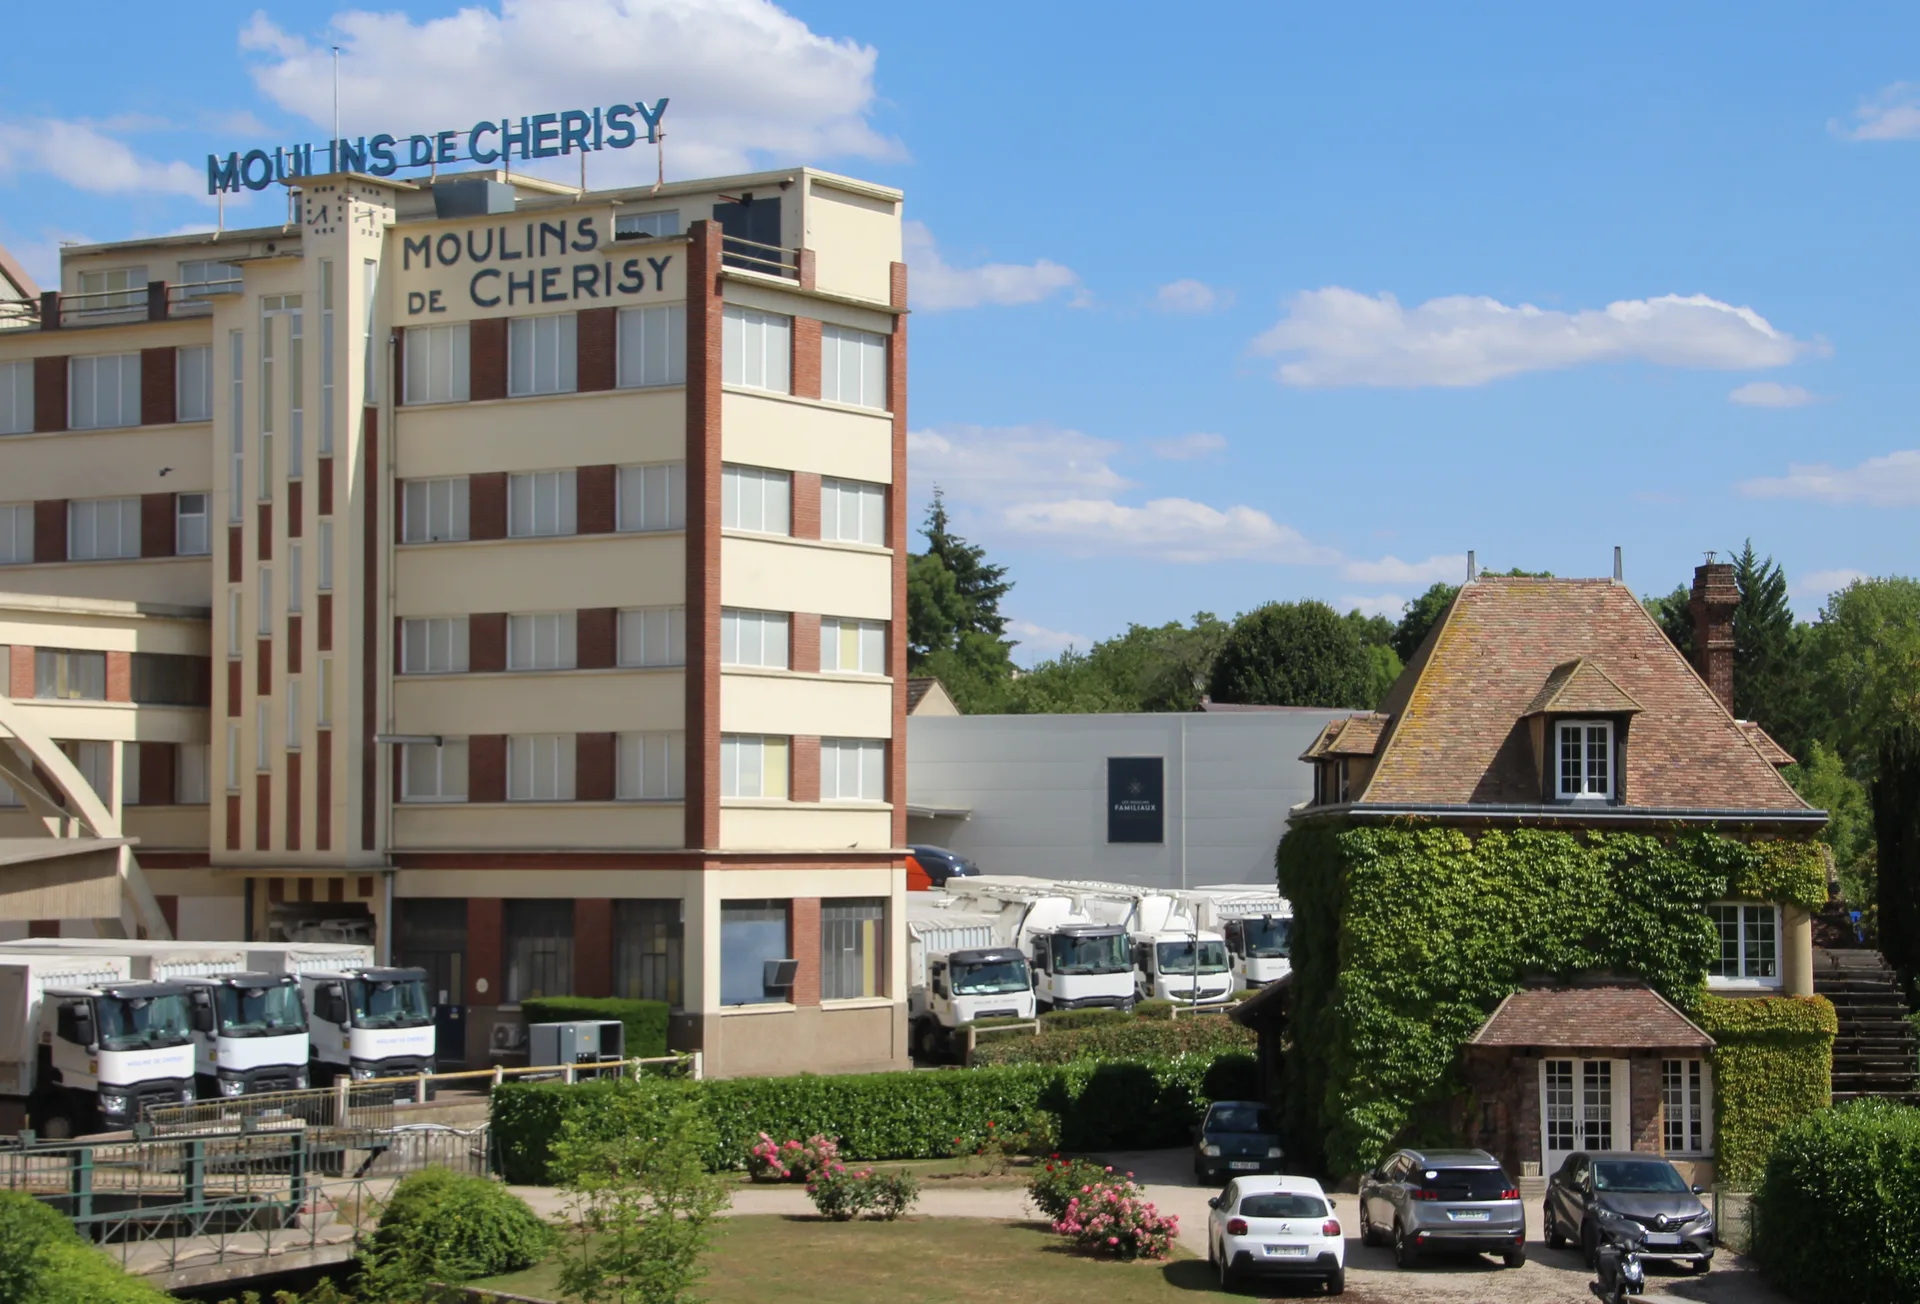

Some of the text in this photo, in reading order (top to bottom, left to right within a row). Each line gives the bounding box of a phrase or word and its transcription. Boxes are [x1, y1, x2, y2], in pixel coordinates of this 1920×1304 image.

[410, 131, 456, 167] DE
[469, 98, 669, 164] CHERISY
[403, 217, 598, 271] MOULINS
[408, 256, 672, 315] DE CHERISY
